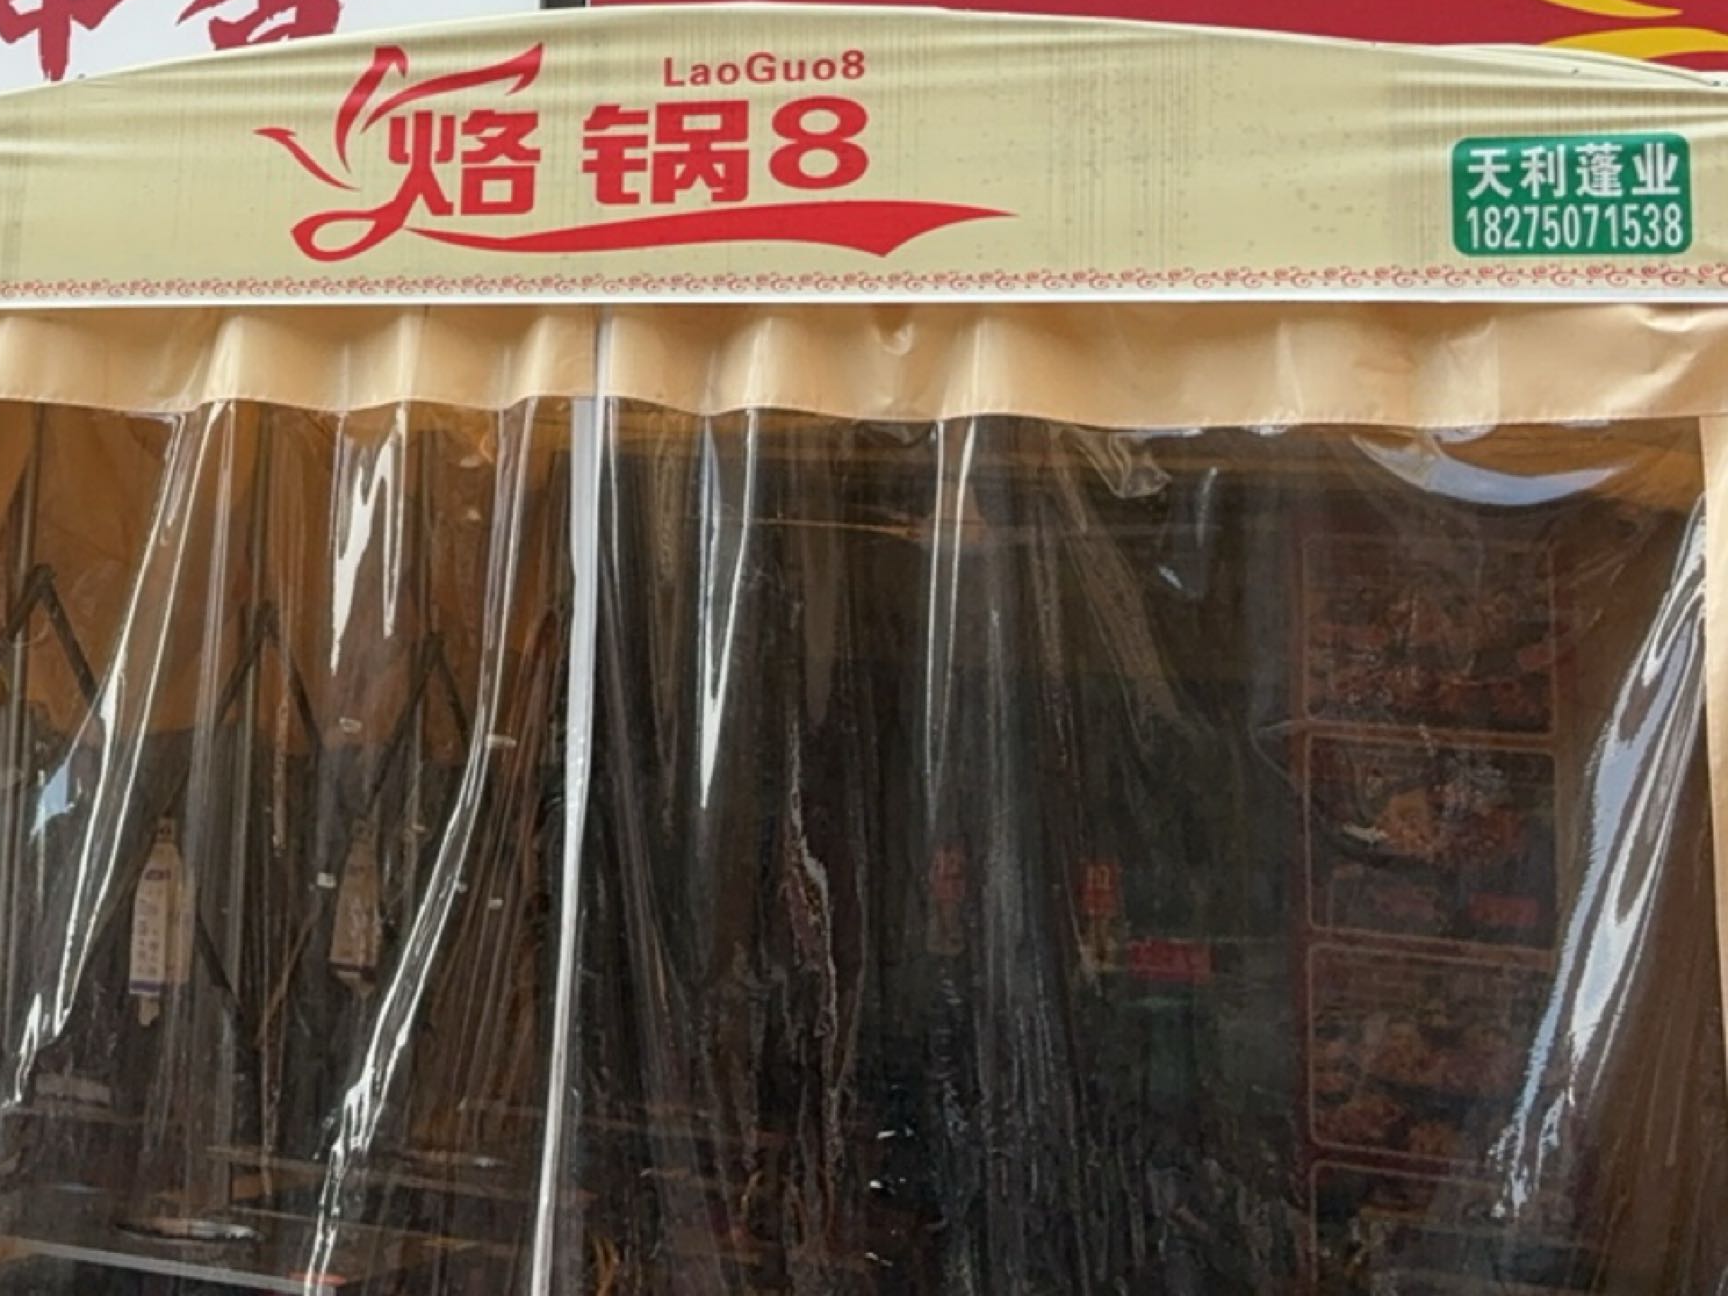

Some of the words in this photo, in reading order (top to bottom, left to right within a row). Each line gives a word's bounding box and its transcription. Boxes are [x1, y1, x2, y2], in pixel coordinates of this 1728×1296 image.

[662, 47, 867, 88] LaoGuo8
[387, 95, 870, 217] 烙锅8
[1466, 141, 1681, 199] 天利蓬业
[1467, 202, 1683, 249] 18275071538
